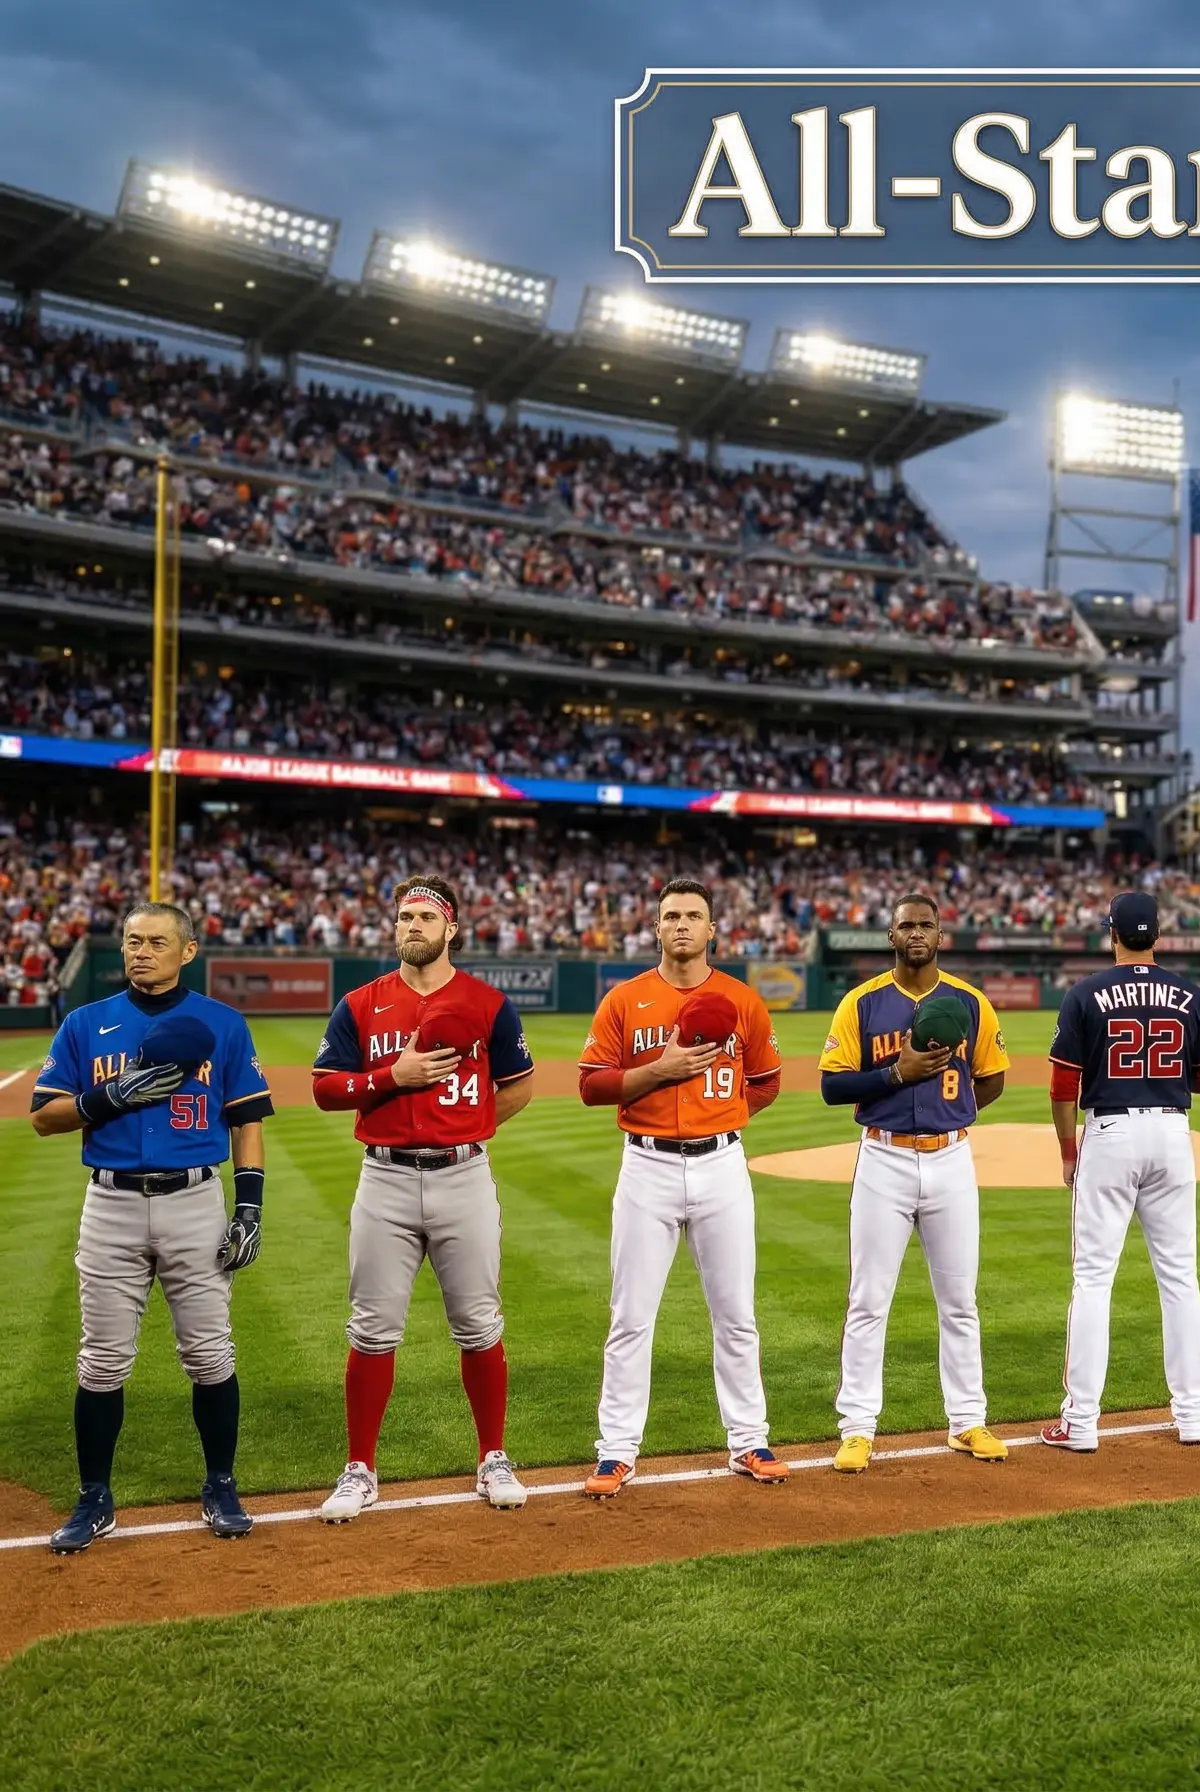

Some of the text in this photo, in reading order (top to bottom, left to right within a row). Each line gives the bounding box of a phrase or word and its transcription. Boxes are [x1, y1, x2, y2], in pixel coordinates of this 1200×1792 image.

[1094, 983, 1194, 1014] MARTINEZ
[1108, 1018, 1185, 1079] 22
[438, 1073, 479, 1106] 34
[703, 1067, 734, 1099] 19
[941, 1069, 961, 1101] 8
[170, 1094, 208, 1129] 51
